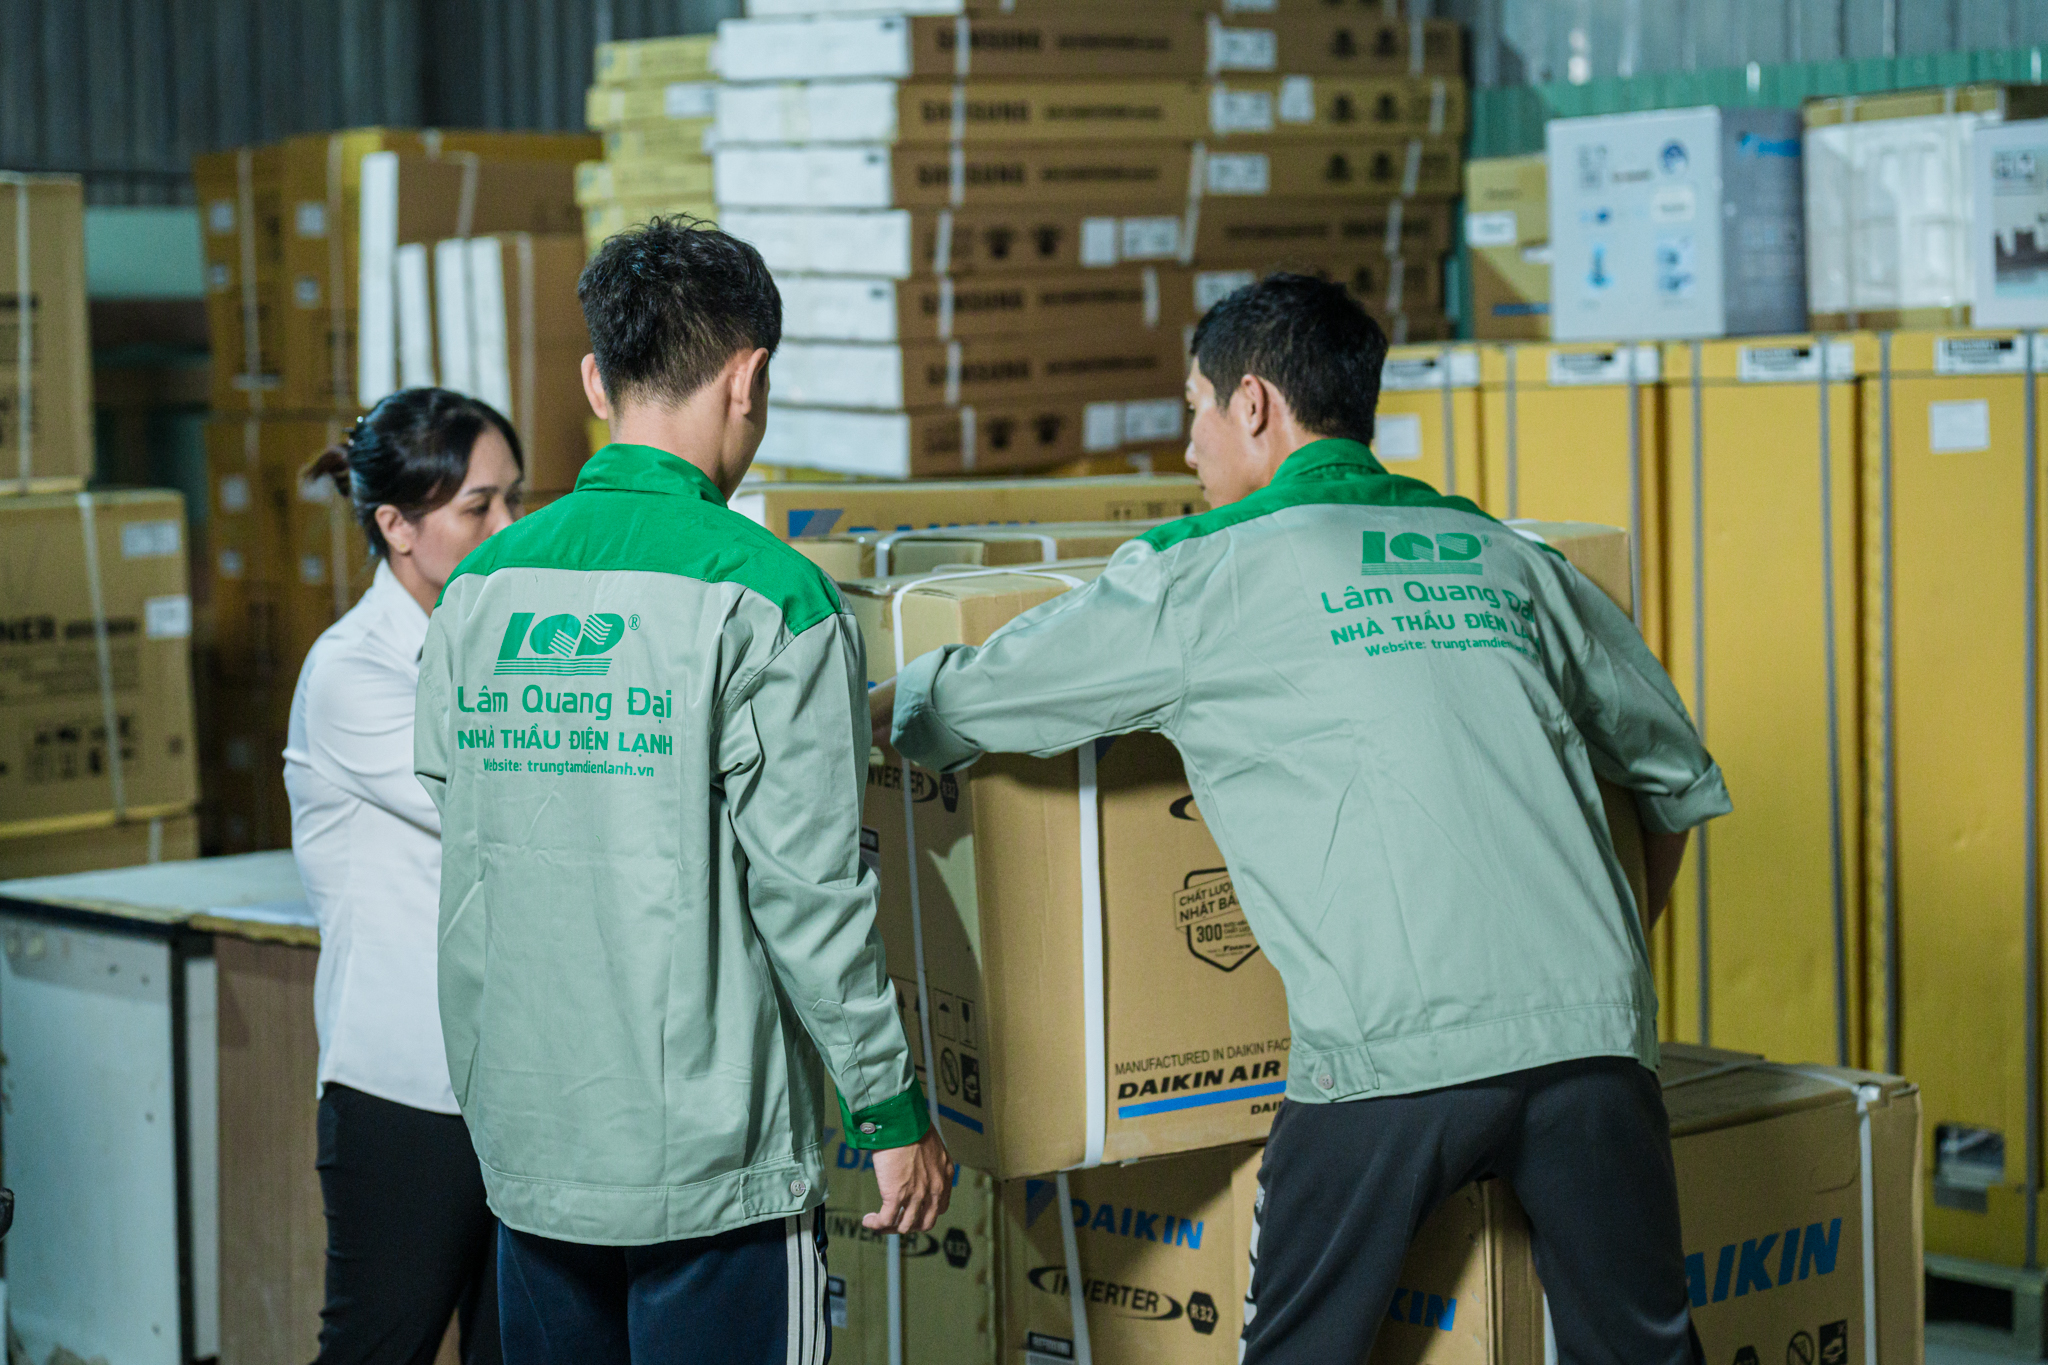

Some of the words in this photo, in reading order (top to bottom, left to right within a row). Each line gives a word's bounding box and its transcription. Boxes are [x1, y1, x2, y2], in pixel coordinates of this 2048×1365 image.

[1321, 586, 1393, 614] Lâm
[1403, 581, 1500, 608] Quang
[1330, 617, 1384, 646] NHÀ
[1392, 609, 1455, 632] THẦU
[1364, 639, 1426, 657] Website:
[457, 685, 508, 713] Lâm
[522, 684, 612, 721] Quang
[627, 686, 672, 723] Đại
[457, 725, 495, 750] NHÀ
[500, 723, 561, 750] THẦU
[569, 726, 608, 754] ĐIỆN
[618, 731, 673, 757] LẠNH
[483, 757, 522, 773] Website:
[527, 759, 655, 778] trungtamdienlanh.vn
[1196, 923, 1223, 944] 300
[1115, 1050, 1210, 1076] MANUFACTURED
[1213, 1047, 1225, 1061] IN
[1227, 1042, 1265, 1060] DAIKIN
[1118, 1068, 1225, 1099] DAIKIN
[1229, 1060, 1282, 1083] AIR
[1071, 1198, 1205, 1250] DAIKIN
[1684, 1217, 1843, 1308] AIKIN
[1190, 1302, 1215, 1324] R32
[1389, 1287, 1457, 1331] KIN
